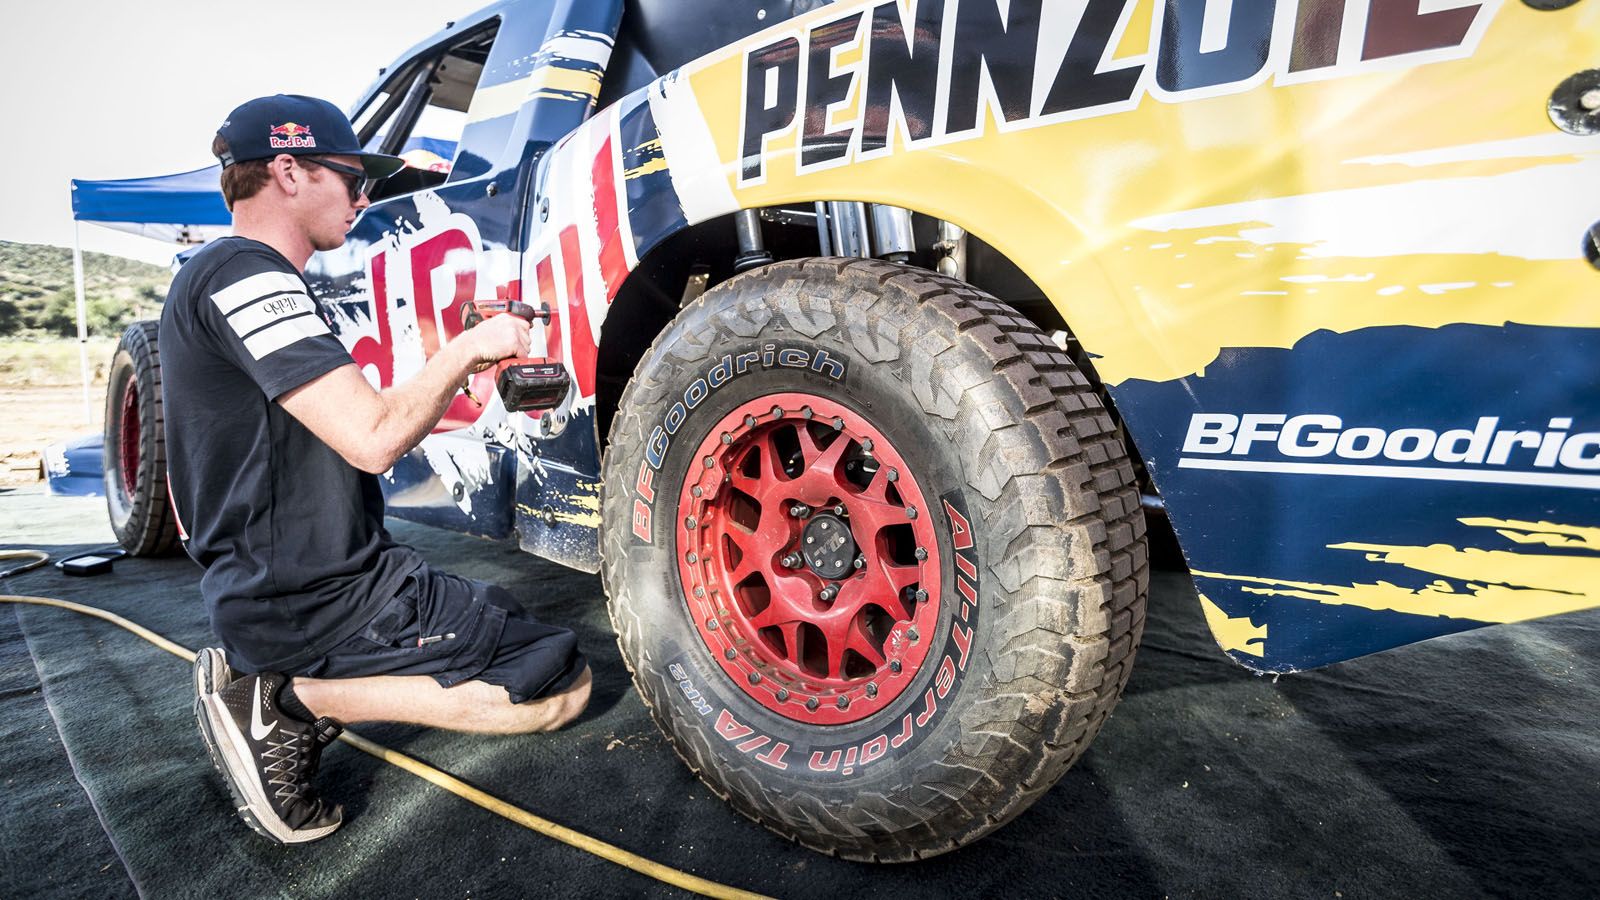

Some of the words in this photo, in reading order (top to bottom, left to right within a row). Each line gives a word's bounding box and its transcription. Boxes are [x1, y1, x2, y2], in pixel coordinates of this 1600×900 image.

[270, 136, 294, 148] Red
[295, 136, 317, 148] Bull
[263, 296, 298, 315] ilabb
[632, 344, 845, 543] BFGoodrich
[808, 499, 978, 775] All-Terrain
[668, 663, 713, 716] KR2
[714, 708, 790, 770] T/A
